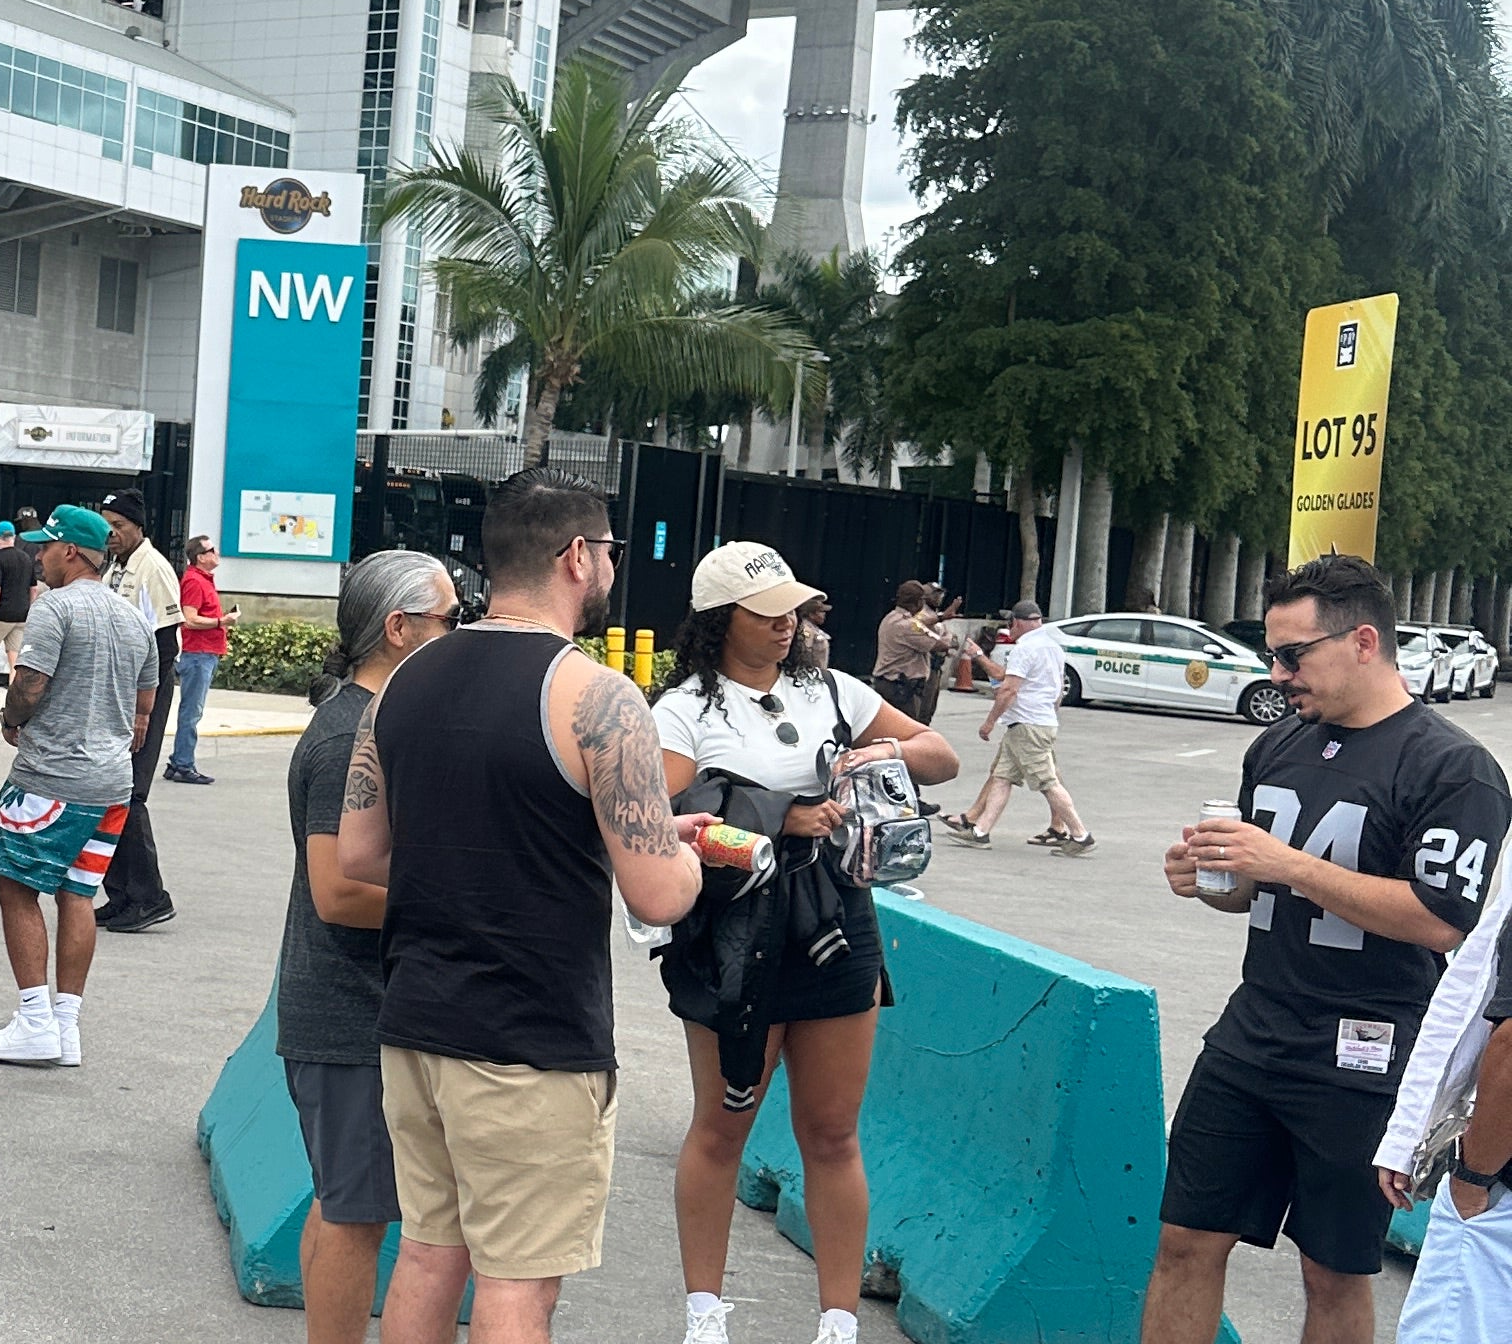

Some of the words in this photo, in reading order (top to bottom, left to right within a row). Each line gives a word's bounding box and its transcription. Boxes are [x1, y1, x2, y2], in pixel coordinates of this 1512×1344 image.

[240, 186, 287, 209] Hard
[287, 190, 332, 217] Rock
[248, 270, 355, 323] NW
[1301, 416, 1347, 461] LOT
[1351, 412, 1378, 457] 95
[1296, 493, 1336, 512] GOLDEN
[1337, 491, 1375, 510] GLADES
[1094, 659, 1141, 675] POLICE
[1414, 827, 1488, 904] 24
